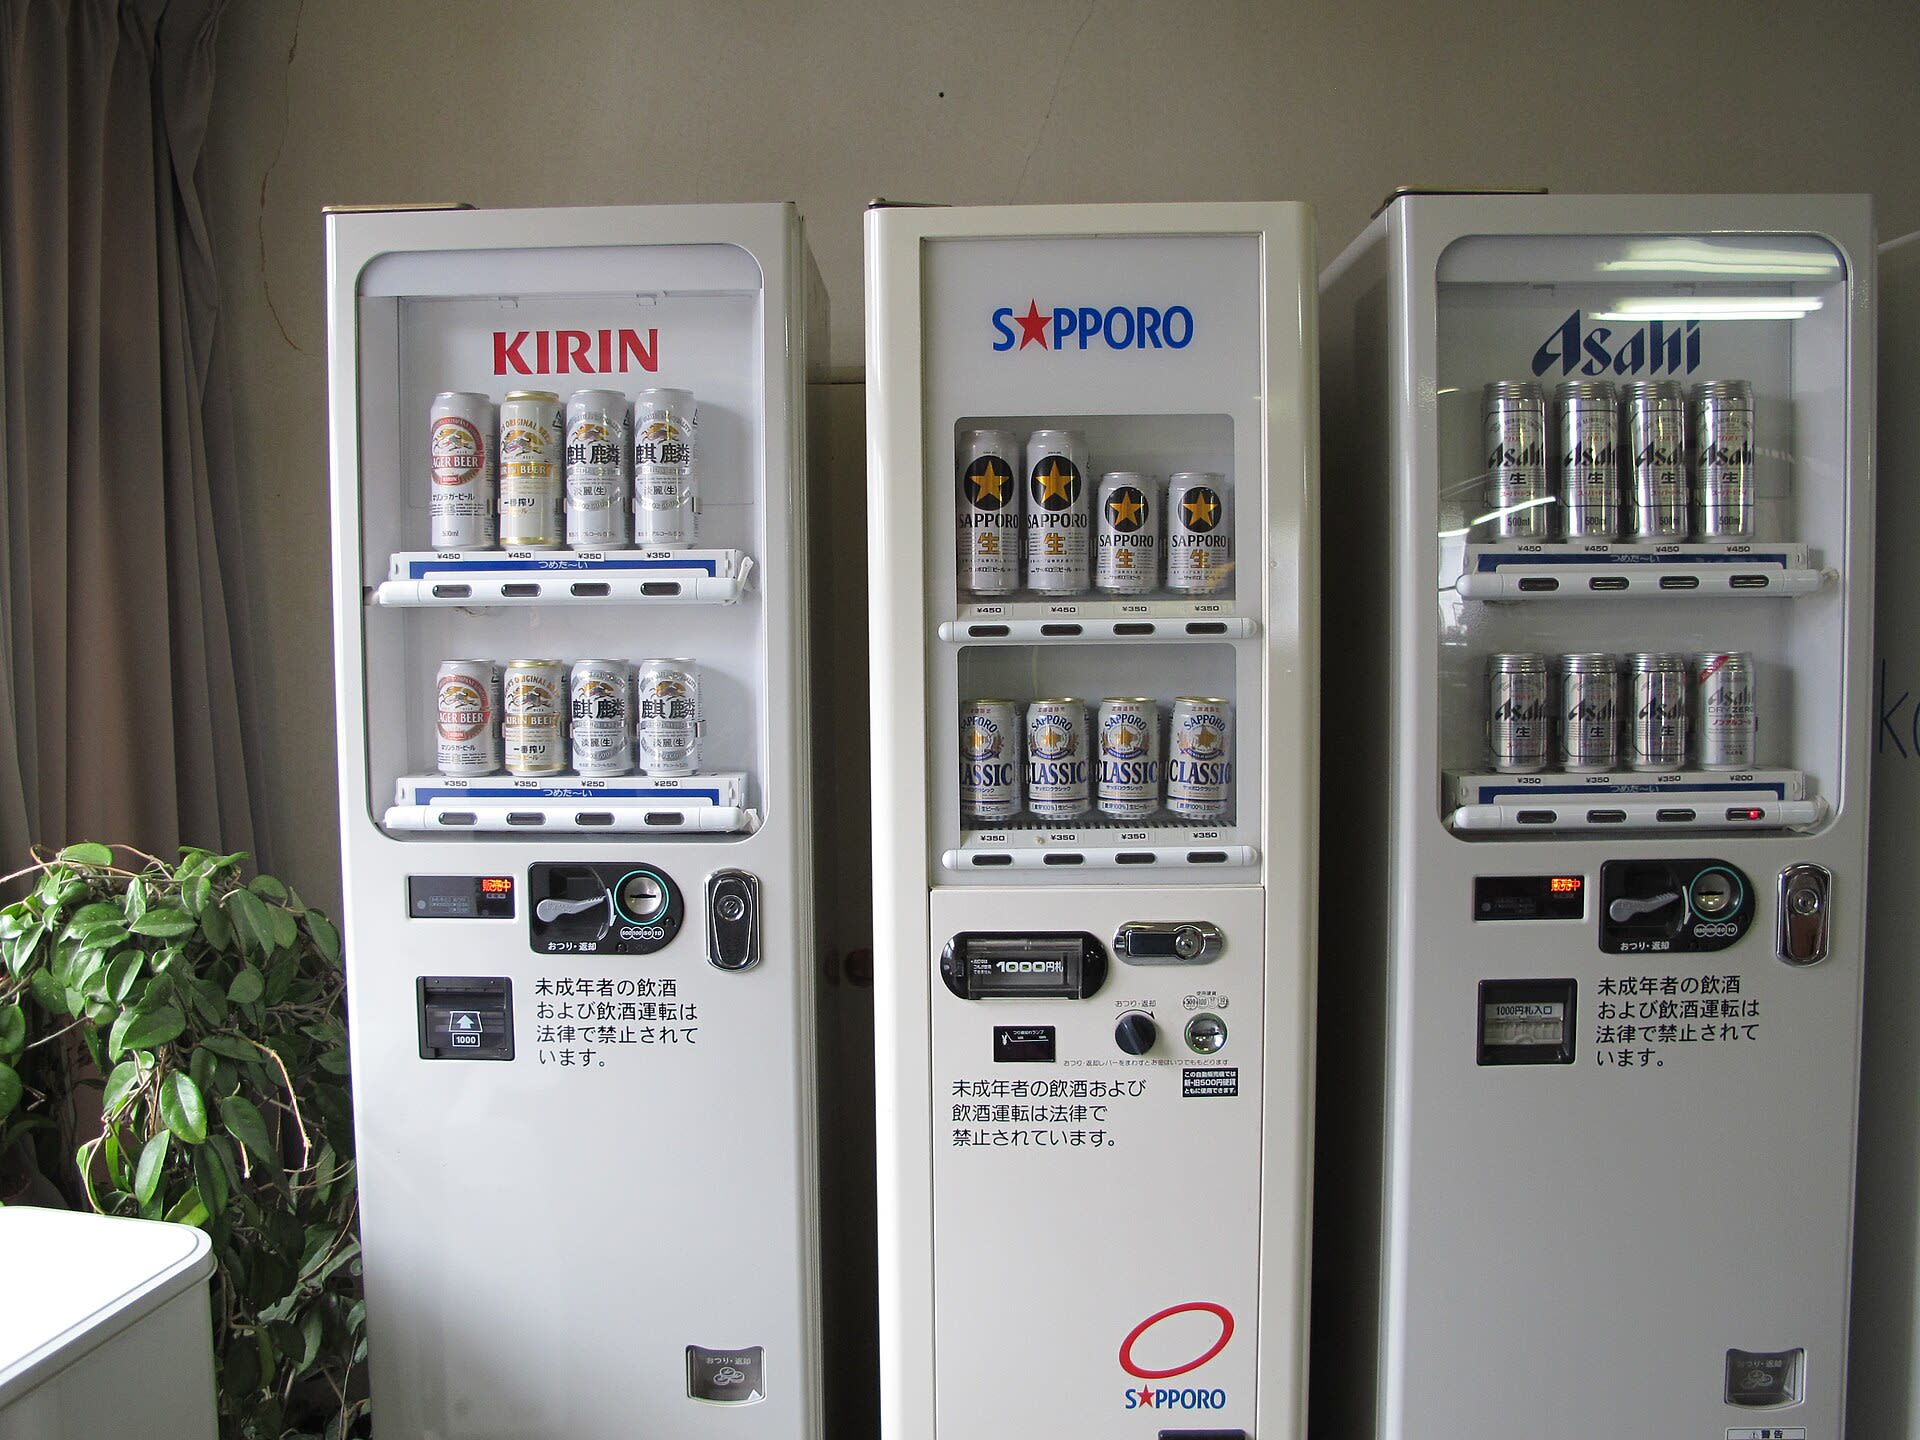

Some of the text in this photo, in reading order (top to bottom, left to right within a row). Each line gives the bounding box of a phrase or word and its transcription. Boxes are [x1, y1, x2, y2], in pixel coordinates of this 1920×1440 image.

[1532, 309, 1701, 376] Asahi
[492, 328, 658, 376] KIRIN
[432, 456, 478, 468] AGER BEER
[568, 444, 620, 464] 麒麟
[636, 443, 690, 464] 麒麟
[521, 465, 546, 474] BEER
[1588, 472, 1604, 485] 生
[1661, 472, 1676, 484] 生
[1722, 472, 1739, 484] 生
[1509, 473, 1526, 485] 生
[959, 514, 1018, 528] SAPPORO
[1028, 513, 1087, 529] SAPPORO
[1507, 517, 1530, 526] 500ml
[978, 532, 1000, 555] 生
[1043, 532, 1067, 555] 生
[1100, 535, 1154, 548] SAPPORO
[1172, 535, 1227, 548] SAPPORO
[1115, 548, 1136, 568] 生
[1189, 549, 1210, 569] 生
[439, 712, 483, 723] AGER BEER
[572, 698, 625, 719] 麒麟
[641, 698, 696, 719] 麒麟
[1031, 714, 1073, 732] SAPPORO
[1104, 713, 1148, 731] SAPPORO
[1183, 714, 1227, 732] SAPPORO
[1661, 725, 1676, 737] 生
[1515, 727, 1531, 737] 生
[1590, 727, 1605, 738] 生
[960, 763, 1013, 787] LASSIC
[1095, 759, 1158, 785] CLASSIC
[1169, 758, 1233, 785] CLASSIC
[482, 879, 511, 892] 販売中
[1550, 878, 1581, 892] 販売中
[1620, 941, 1670, 951] おつり・返却
[996, 961, 1063, 973] 1000円札
[535, 977, 677, 998] 未成年者の飲酒
[1597, 975, 1741, 995] 未成年者の飲酒
[536, 1001, 698, 1021] および飲酒運転は
[1497, 1005, 1552, 1016] 1000円札入口
[1597, 999, 1760, 1019] および飲酒運転は
[455, 1036, 476, 1044] 1000
[536, 1025, 700, 1044] 法律で禁止されて
[1596, 1022, 1760, 1043] 法律で禁止されて
[538, 1049, 607, 1068] います。
[1597, 1048, 1664, 1067] います。
[952, 1079, 1147, 1098] 未成年者の飲酒および
[952, 1103, 1108, 1123] 飲酒運転は法律で
[952, 1128, 1116, 1147] 禁止されています。
